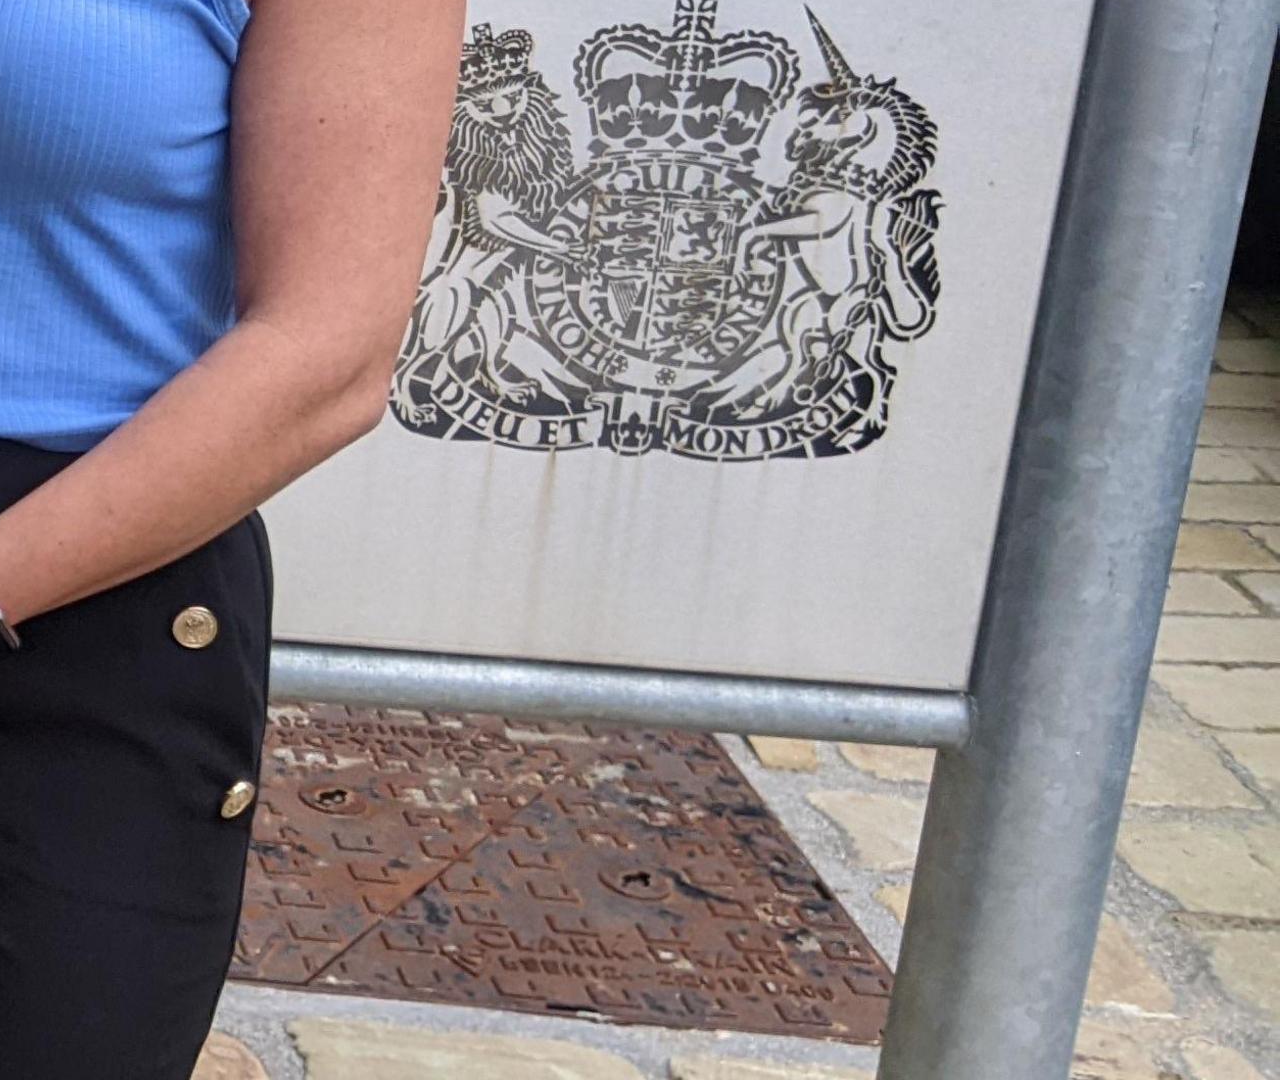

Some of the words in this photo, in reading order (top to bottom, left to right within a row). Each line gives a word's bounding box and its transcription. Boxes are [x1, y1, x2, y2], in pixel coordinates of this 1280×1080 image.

[435, 377, 521, 443] DIEU
[543, 417, 590, 444] ET
[663, 424, 748, 454] MON
[760, 377, 862, 454] DROIT
